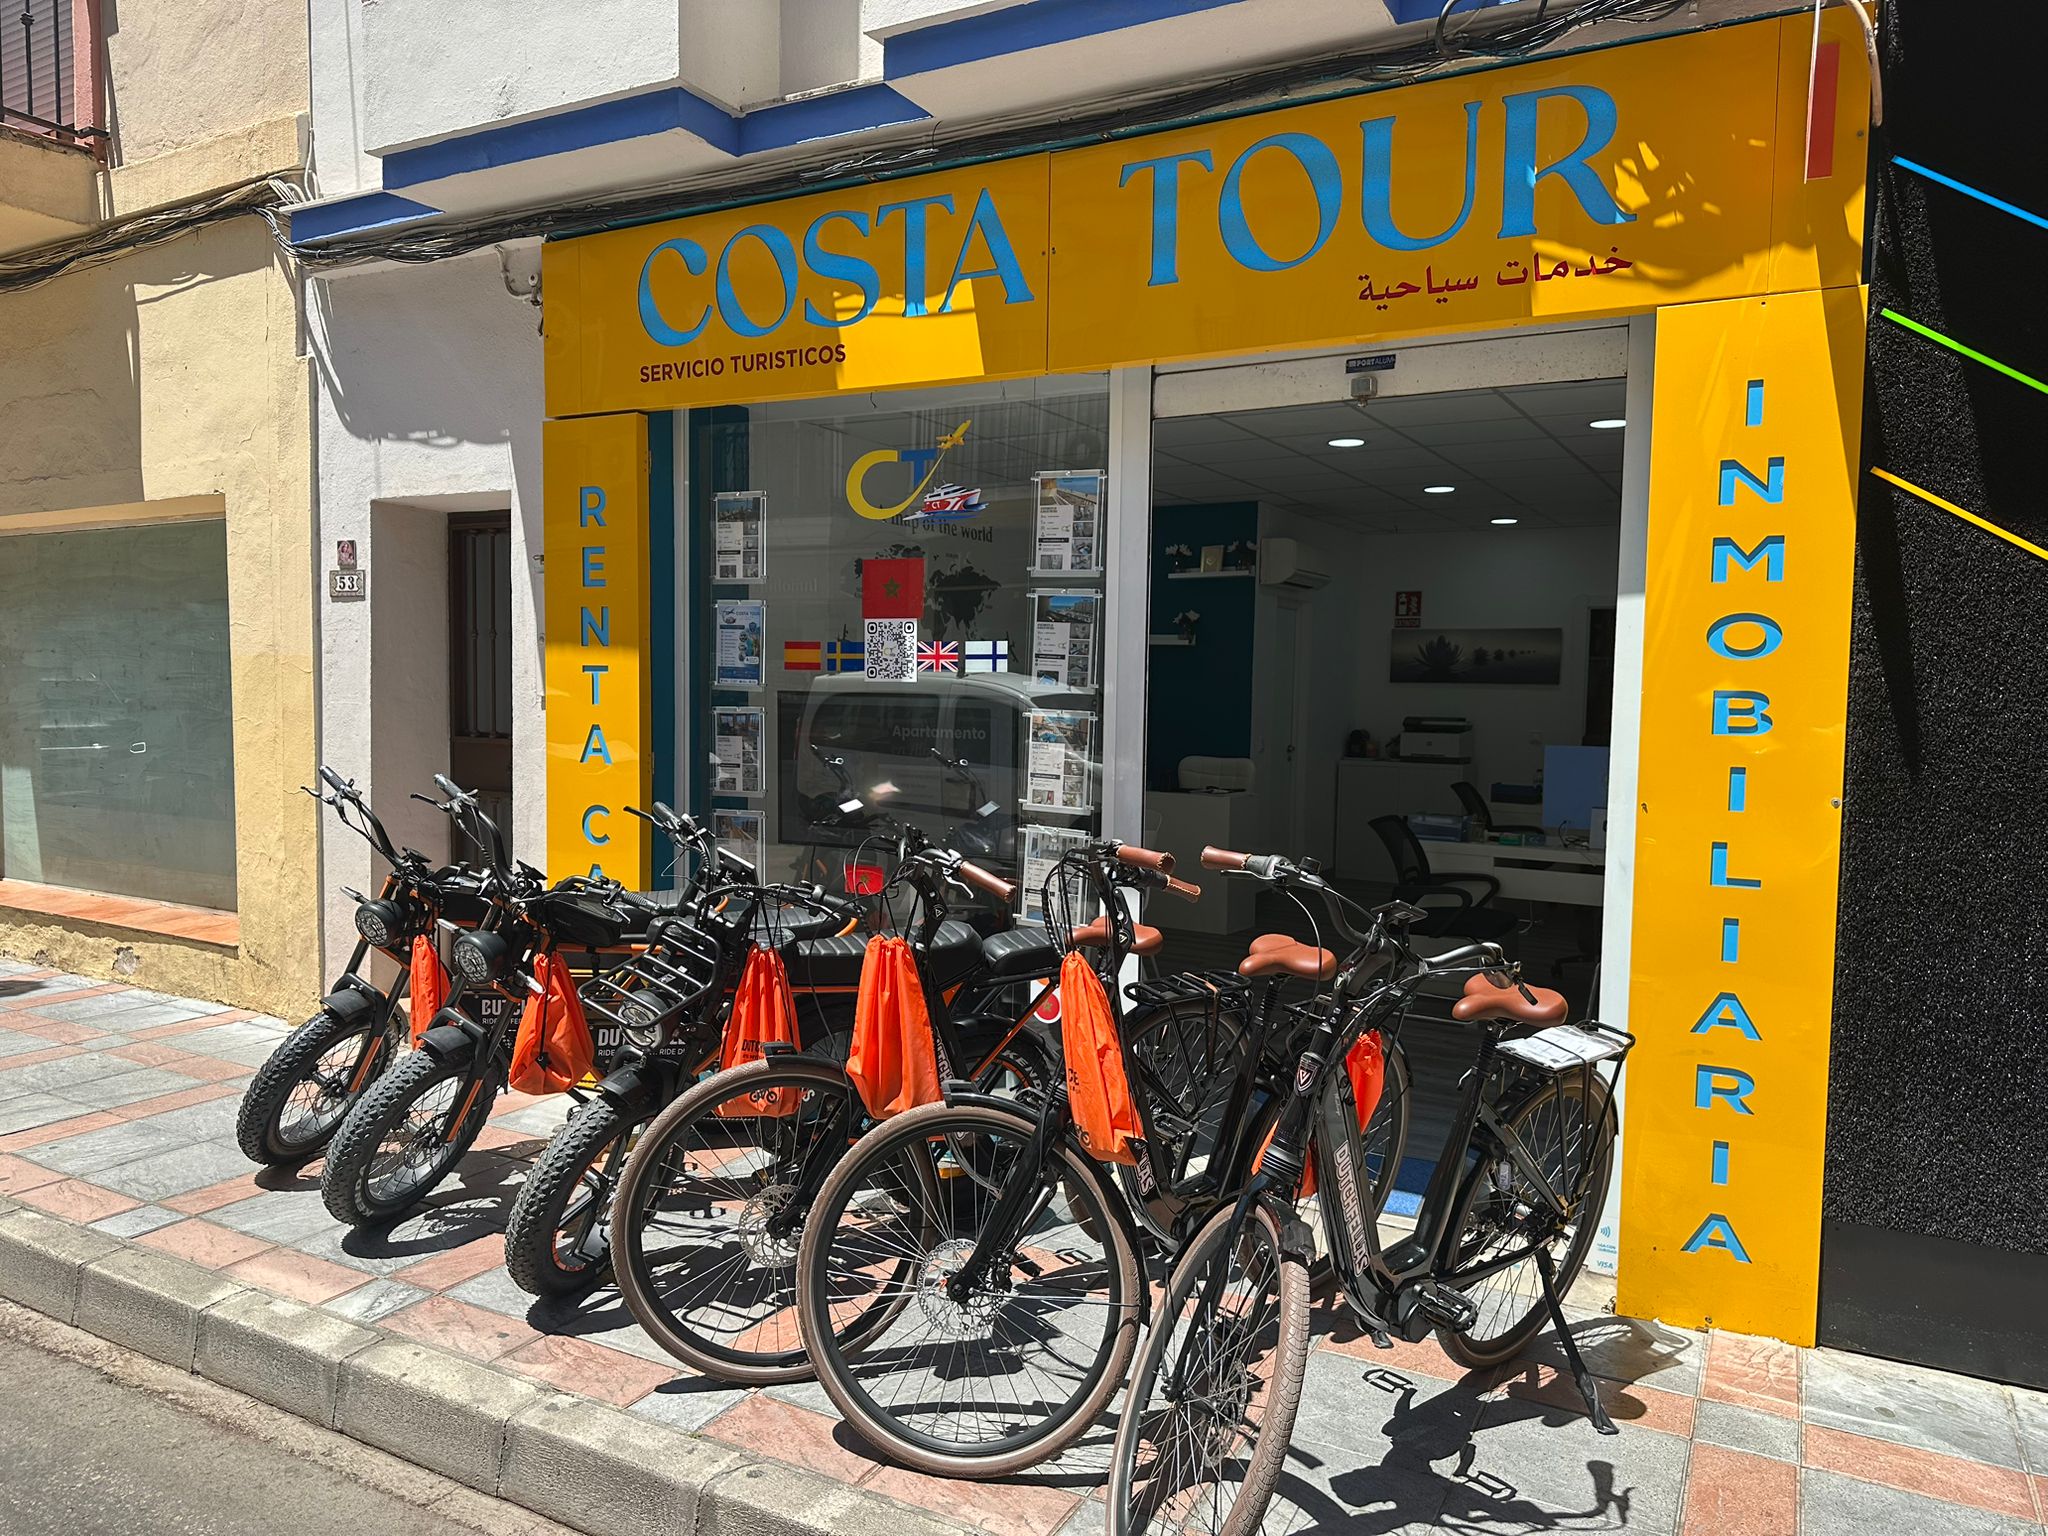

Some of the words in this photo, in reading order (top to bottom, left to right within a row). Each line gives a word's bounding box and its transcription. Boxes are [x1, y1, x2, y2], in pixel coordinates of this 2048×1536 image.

[637, 187, 1035, 346] COSTA
[1118, 83, 1637, 287] TOUR
[1496, 246, 1633, 286] خدمات
[1358, 265, 1479, 311] سياحية
[640, 357, 725, 383] SERVICIO
[730, 344, 847, 374] TURISTICOS
[961, 526, 993, 543] world
[338, 576, 355, 590] 53
[892, 725, 986, 740] Apartamento
[1681, 378, 1786, 1264] INMOBILIARIA
[1333, 1140, 1371, 1278] DUTCHFELLAS
[1596, 1260, 1614, 1269] VISA
